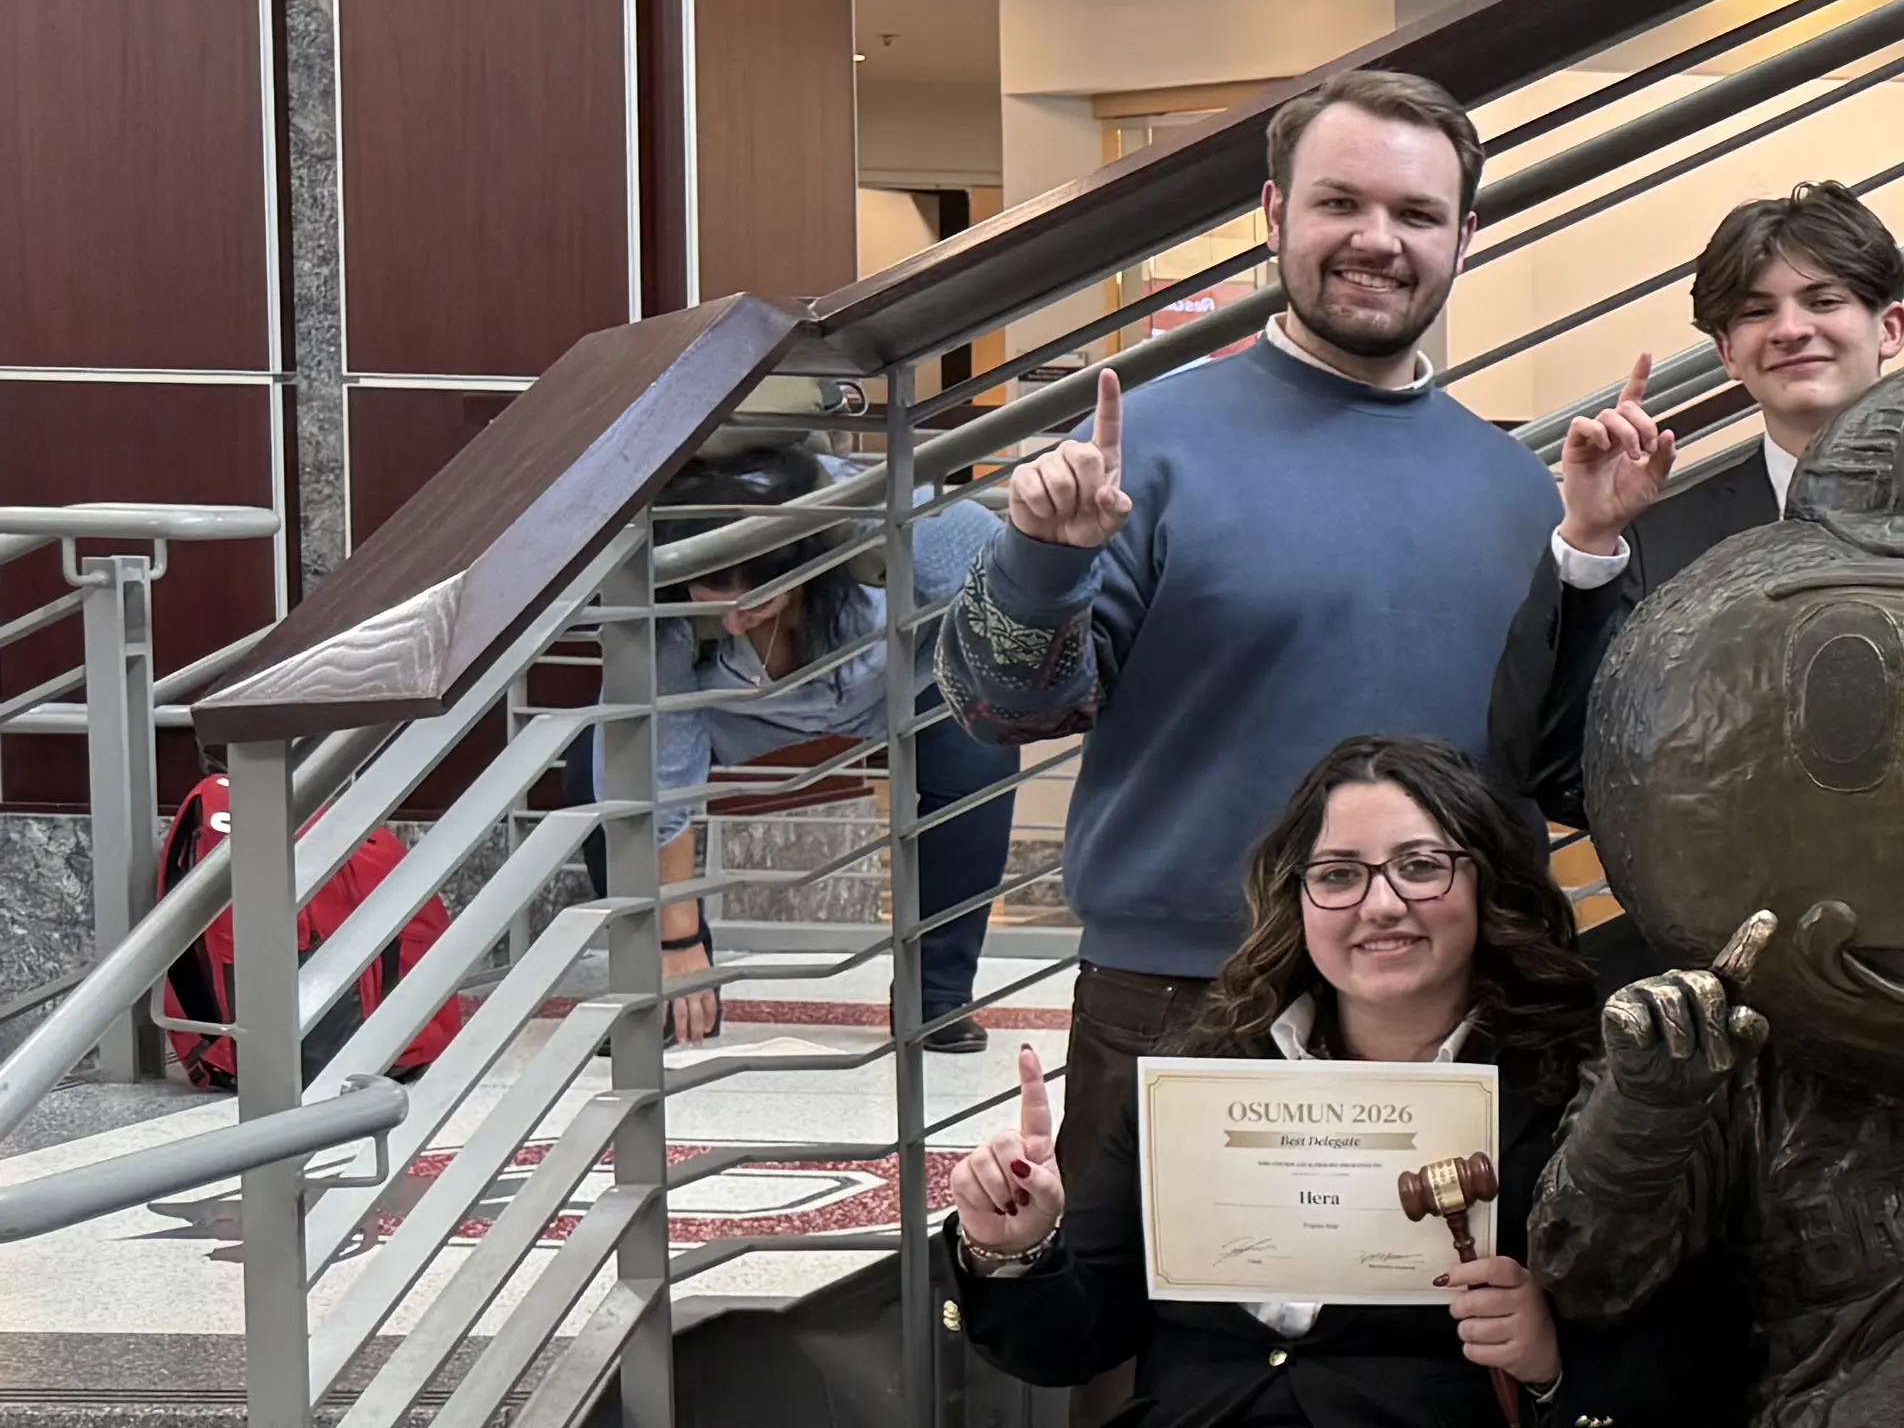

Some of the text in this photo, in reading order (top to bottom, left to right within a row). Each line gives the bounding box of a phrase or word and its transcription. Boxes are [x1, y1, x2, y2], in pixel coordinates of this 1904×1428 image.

[1227, 1101, 1413, 1124] OSUMUN 2026
[1279, 1135, 1362, 1150] Best Delegate
[1299, 1190, 1340, 1206] Hera
